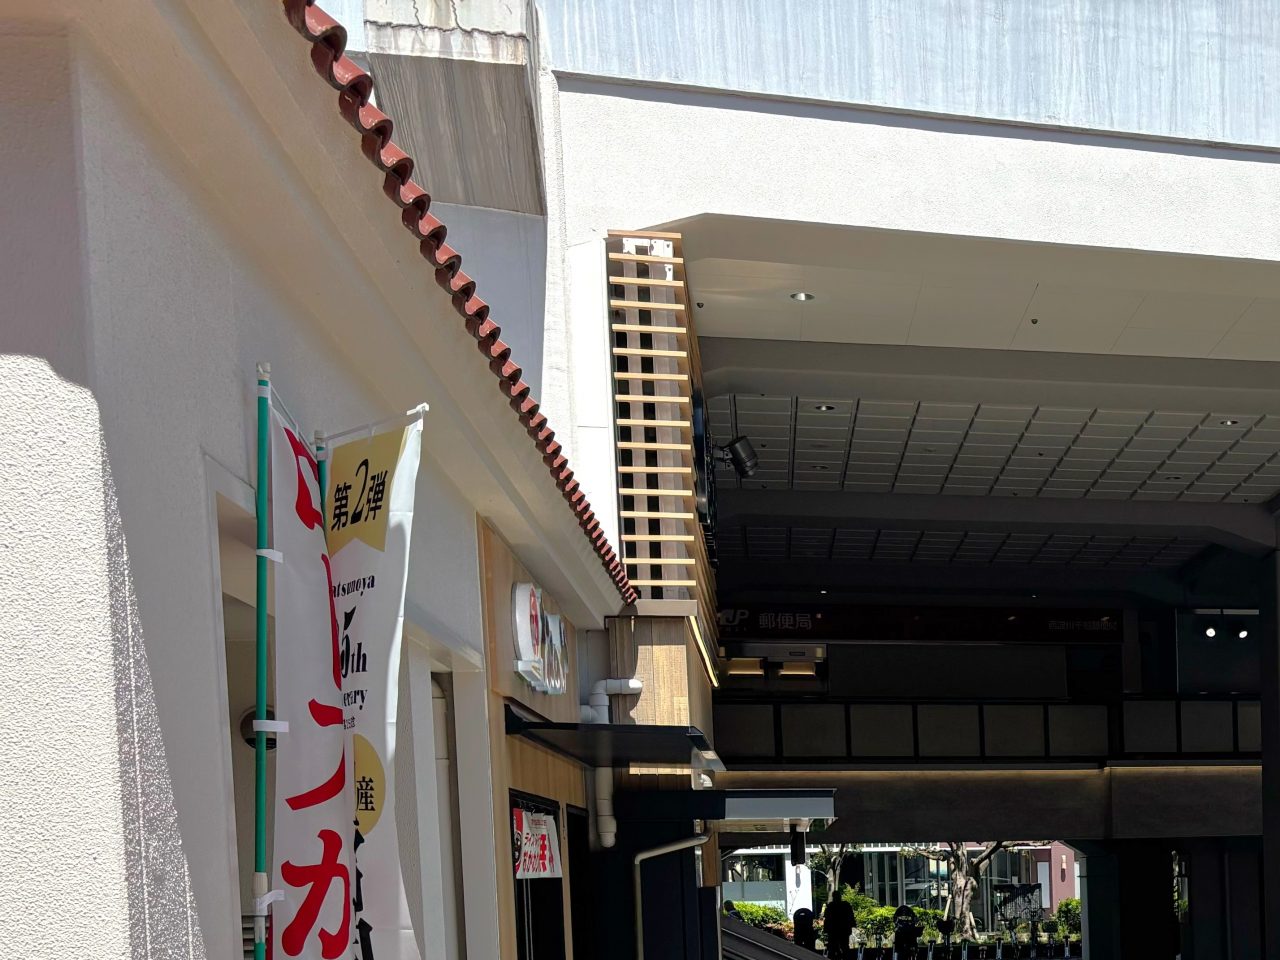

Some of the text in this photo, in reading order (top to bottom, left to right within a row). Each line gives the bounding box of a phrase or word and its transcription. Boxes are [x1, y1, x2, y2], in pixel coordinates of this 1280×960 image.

[331, 458, 388, 531] 第2弾
[332, 574, 375, 597] atsunoya
[759, 612, 812, 630] 郵便局
